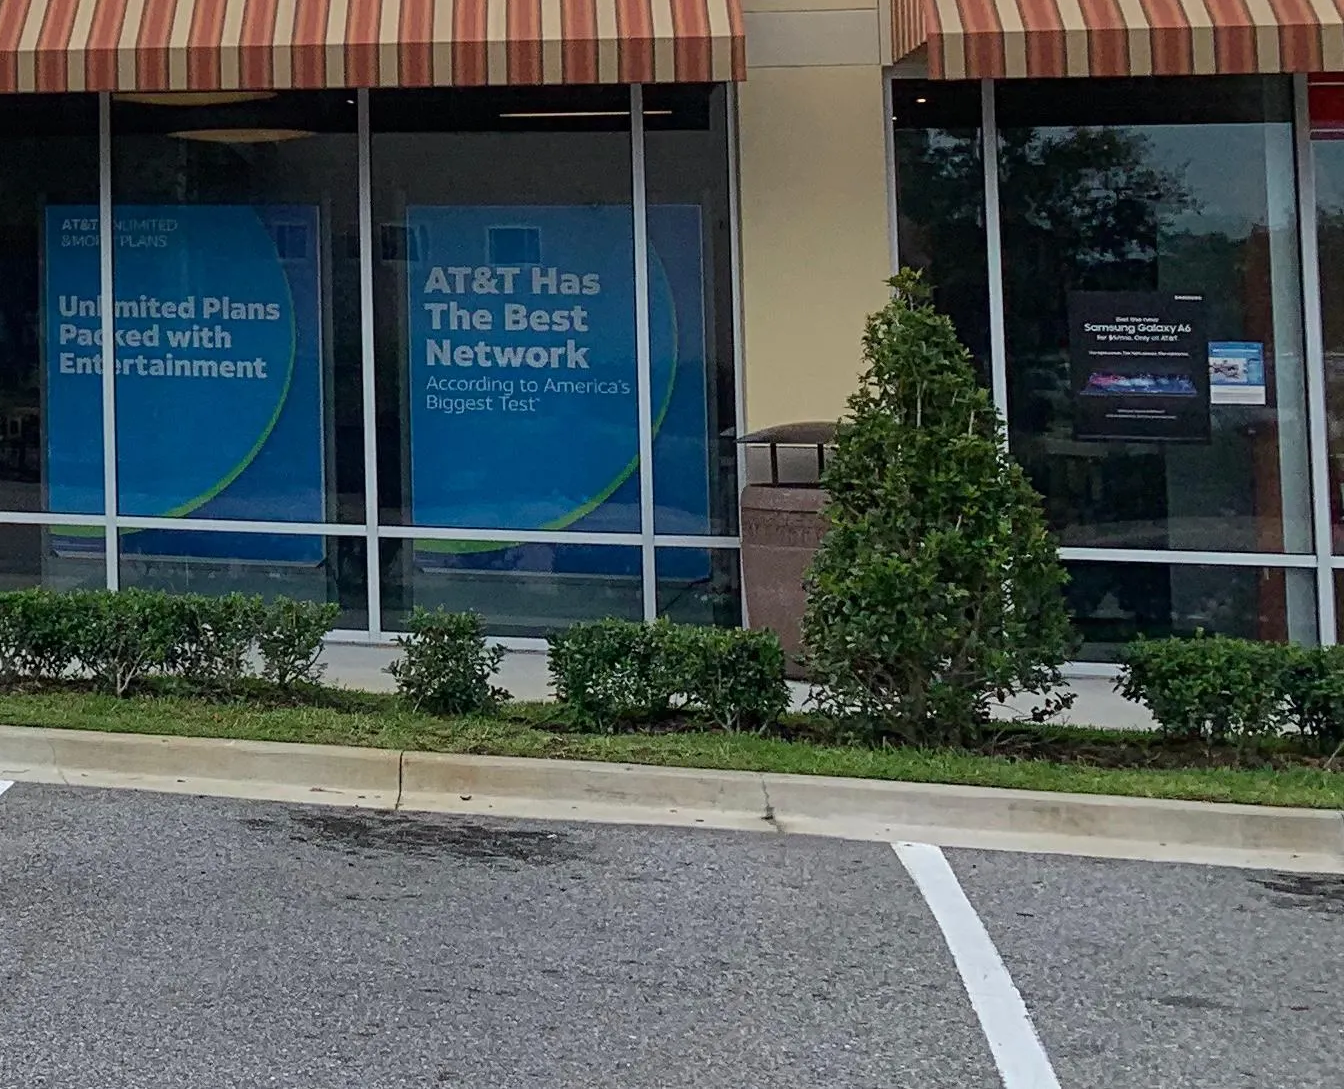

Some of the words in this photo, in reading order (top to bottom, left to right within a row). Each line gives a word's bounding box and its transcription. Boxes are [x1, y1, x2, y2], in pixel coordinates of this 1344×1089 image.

[61, 218, 99, 231] AT&T
[113, 219, 178, 232] NLIMITED
[61, 235, 100, 248] &MO
[120, 235, 168, 248] PLANS
[424, 266, 520, 294] AT&T
[531, 266, 601, 295] Has
[59, 295, 195, 319] Unlmited
[203, 296, 280, 320] Plans
[424, 302, 493, 330] The
[504, 303, 589, 332] Best
[167, 325, 232, 348] with
[1084, 323, 1136, 334] Samsung
[1137, 324, 1176, 334] Galaxy
[1178, 324, 1192, 333] A6
[426, 339, 590, 369] Network
[426, 376, 514, 397] According
[520, 379, 538, 393] to
[543, 378, 631, 394] America's
[426, 395, 493, 414] Biggest
